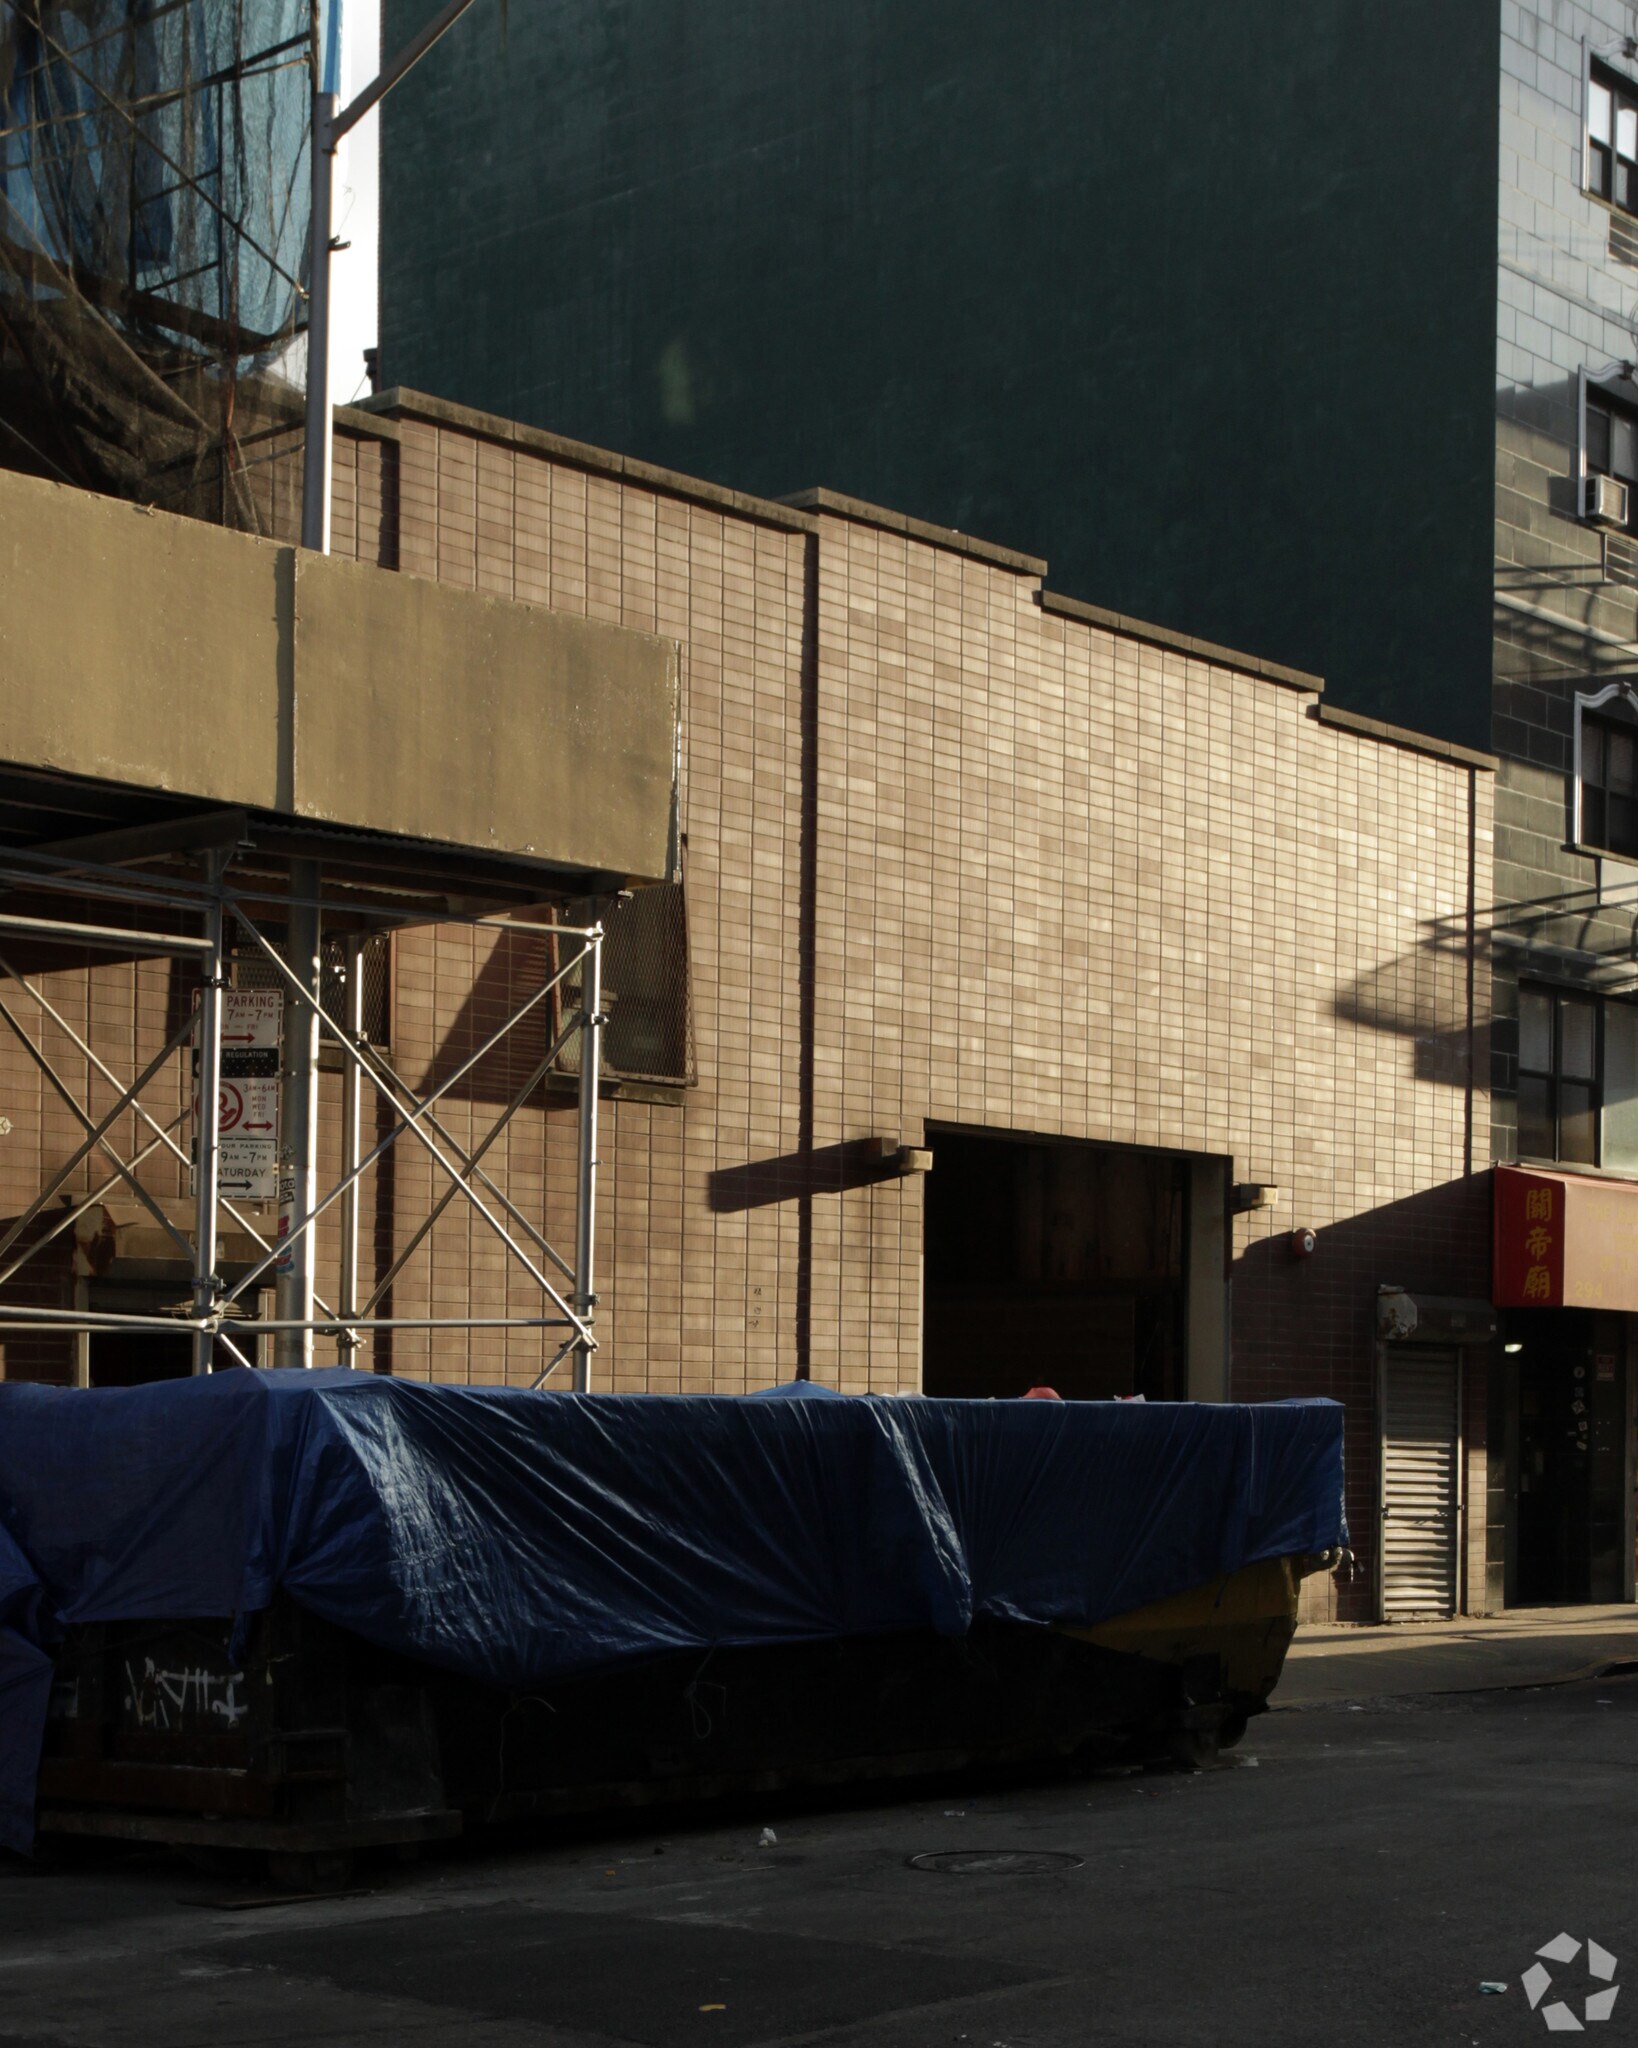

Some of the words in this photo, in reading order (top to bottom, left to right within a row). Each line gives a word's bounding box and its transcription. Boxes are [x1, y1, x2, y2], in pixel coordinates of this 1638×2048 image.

[226, 995, 274, 1008] PARKING
[226, 1051, 269, 1059] REGULATION
[218, 1168, 267, 1178] ATURDAY
